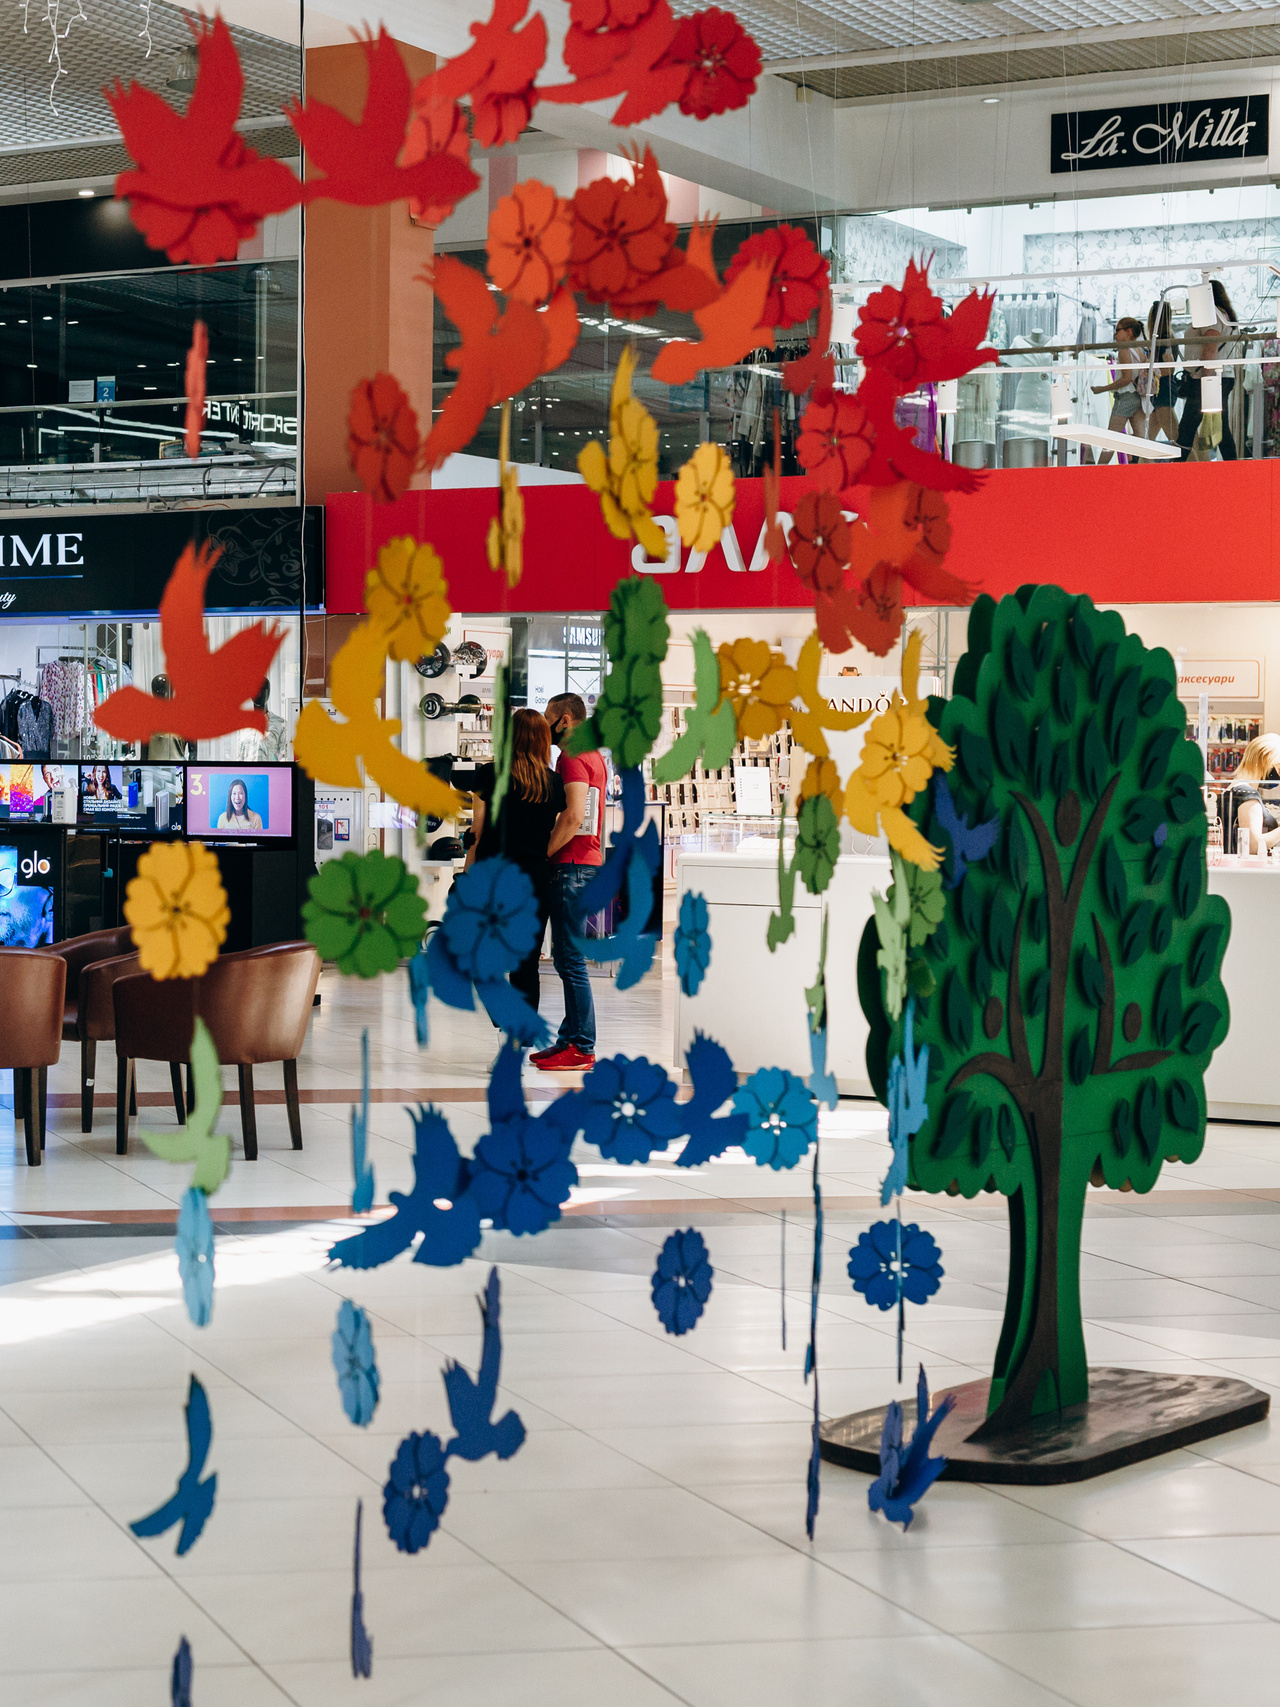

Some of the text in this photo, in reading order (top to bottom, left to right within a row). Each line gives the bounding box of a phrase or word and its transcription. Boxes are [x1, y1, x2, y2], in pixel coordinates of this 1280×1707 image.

[1132, 107, 1257, 154] Milla
[1177, 675, 1235, 686] аксесуари
[190, 774, 206, 796] 3.
[20, 850, 51, 879] glo
